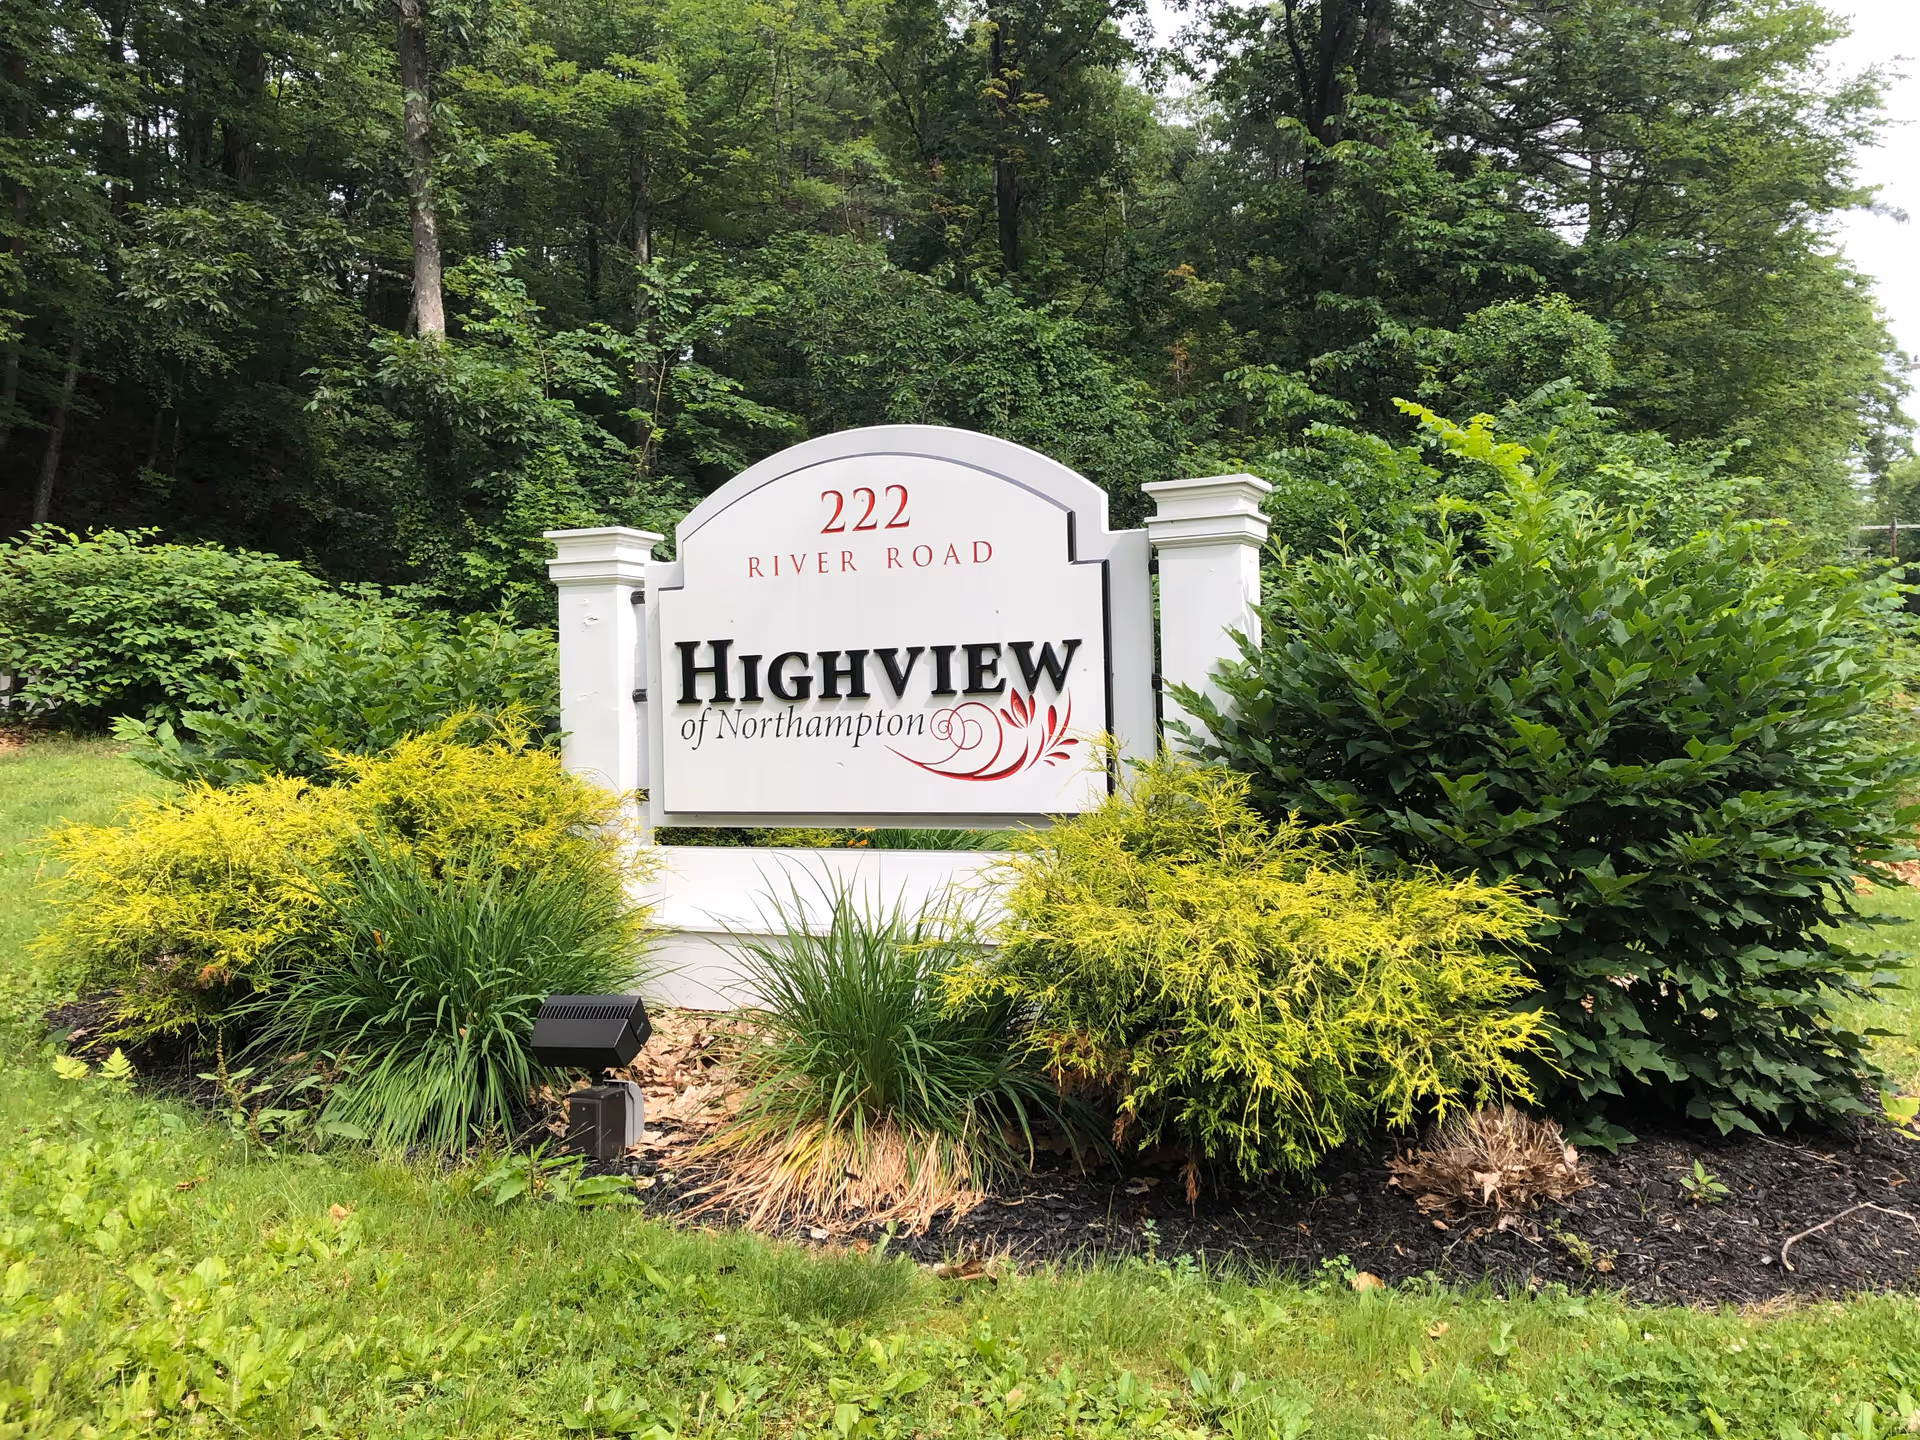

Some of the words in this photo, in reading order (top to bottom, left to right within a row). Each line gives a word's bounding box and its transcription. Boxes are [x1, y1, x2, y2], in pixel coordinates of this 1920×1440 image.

[820, 485, 911, 534] 222
[748, 551, 857, 578] RIVER
[887, 541, 994, 569] ROAD
[674, 638, 1083, 705] HIGHVIEW
[681, 708, 711, 750] of
[717, 705, 926, 748] Northampton
